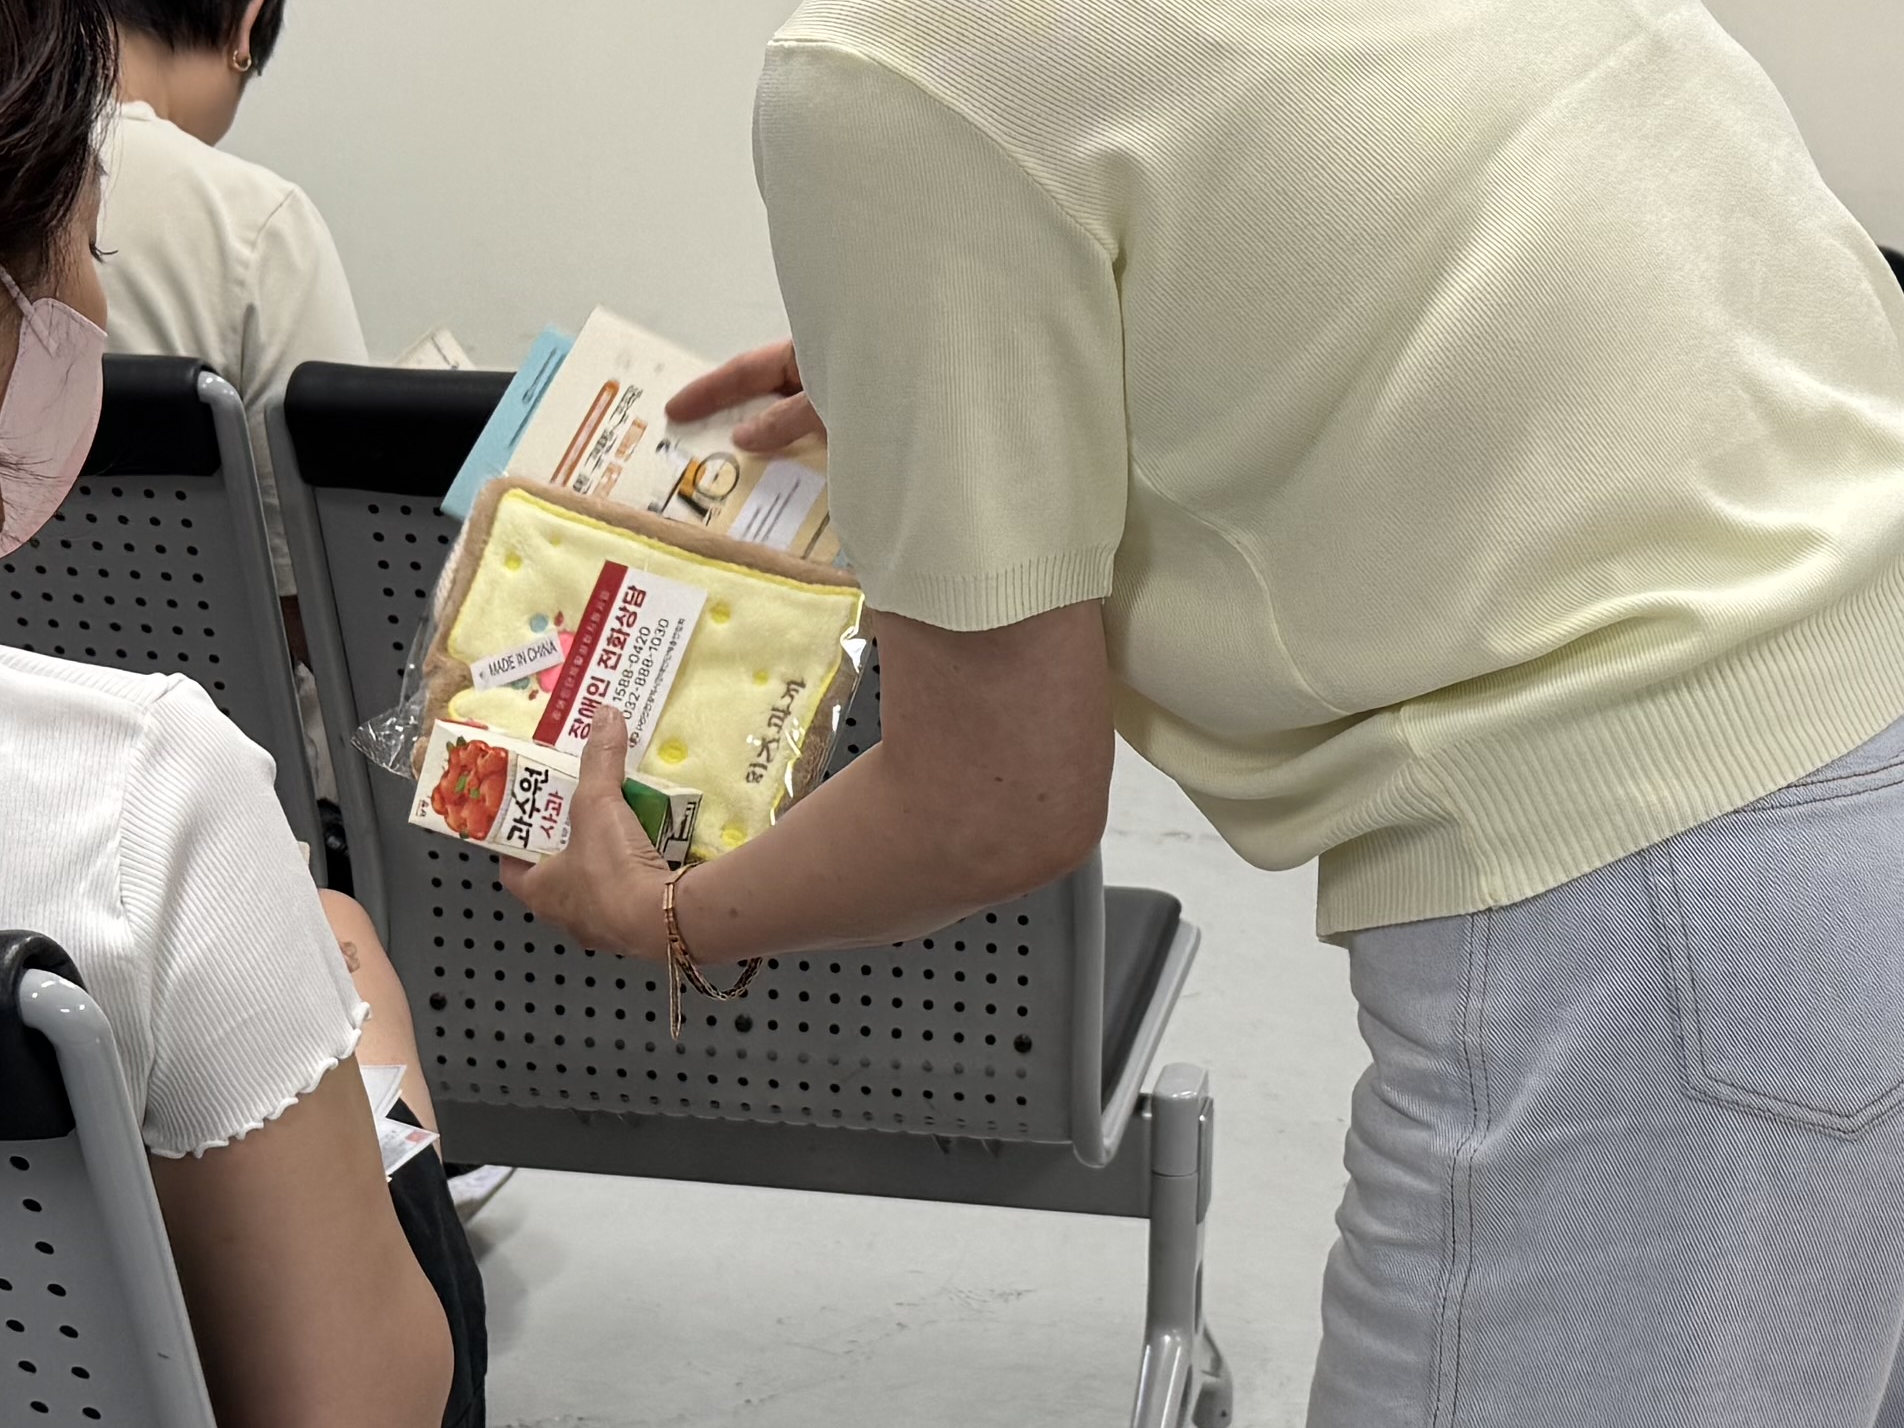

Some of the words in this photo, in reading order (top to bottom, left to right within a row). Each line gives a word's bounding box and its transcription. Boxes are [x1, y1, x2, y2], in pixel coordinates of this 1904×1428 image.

[488, 654, 516, 676] MADE
[516, 649, 528, 667] IN
[527, 639, 558, 662] CHINA
[568, 676, 611, 740] 장애인
[597, 585, 647, 671] 전화상담
[612, 625, 651, 703] 1588-0420
[623, 618, 670, 720] 032-888-1030
[506, 766, 549, 849] 과수원
[540, 789, 564, 839] 사과
